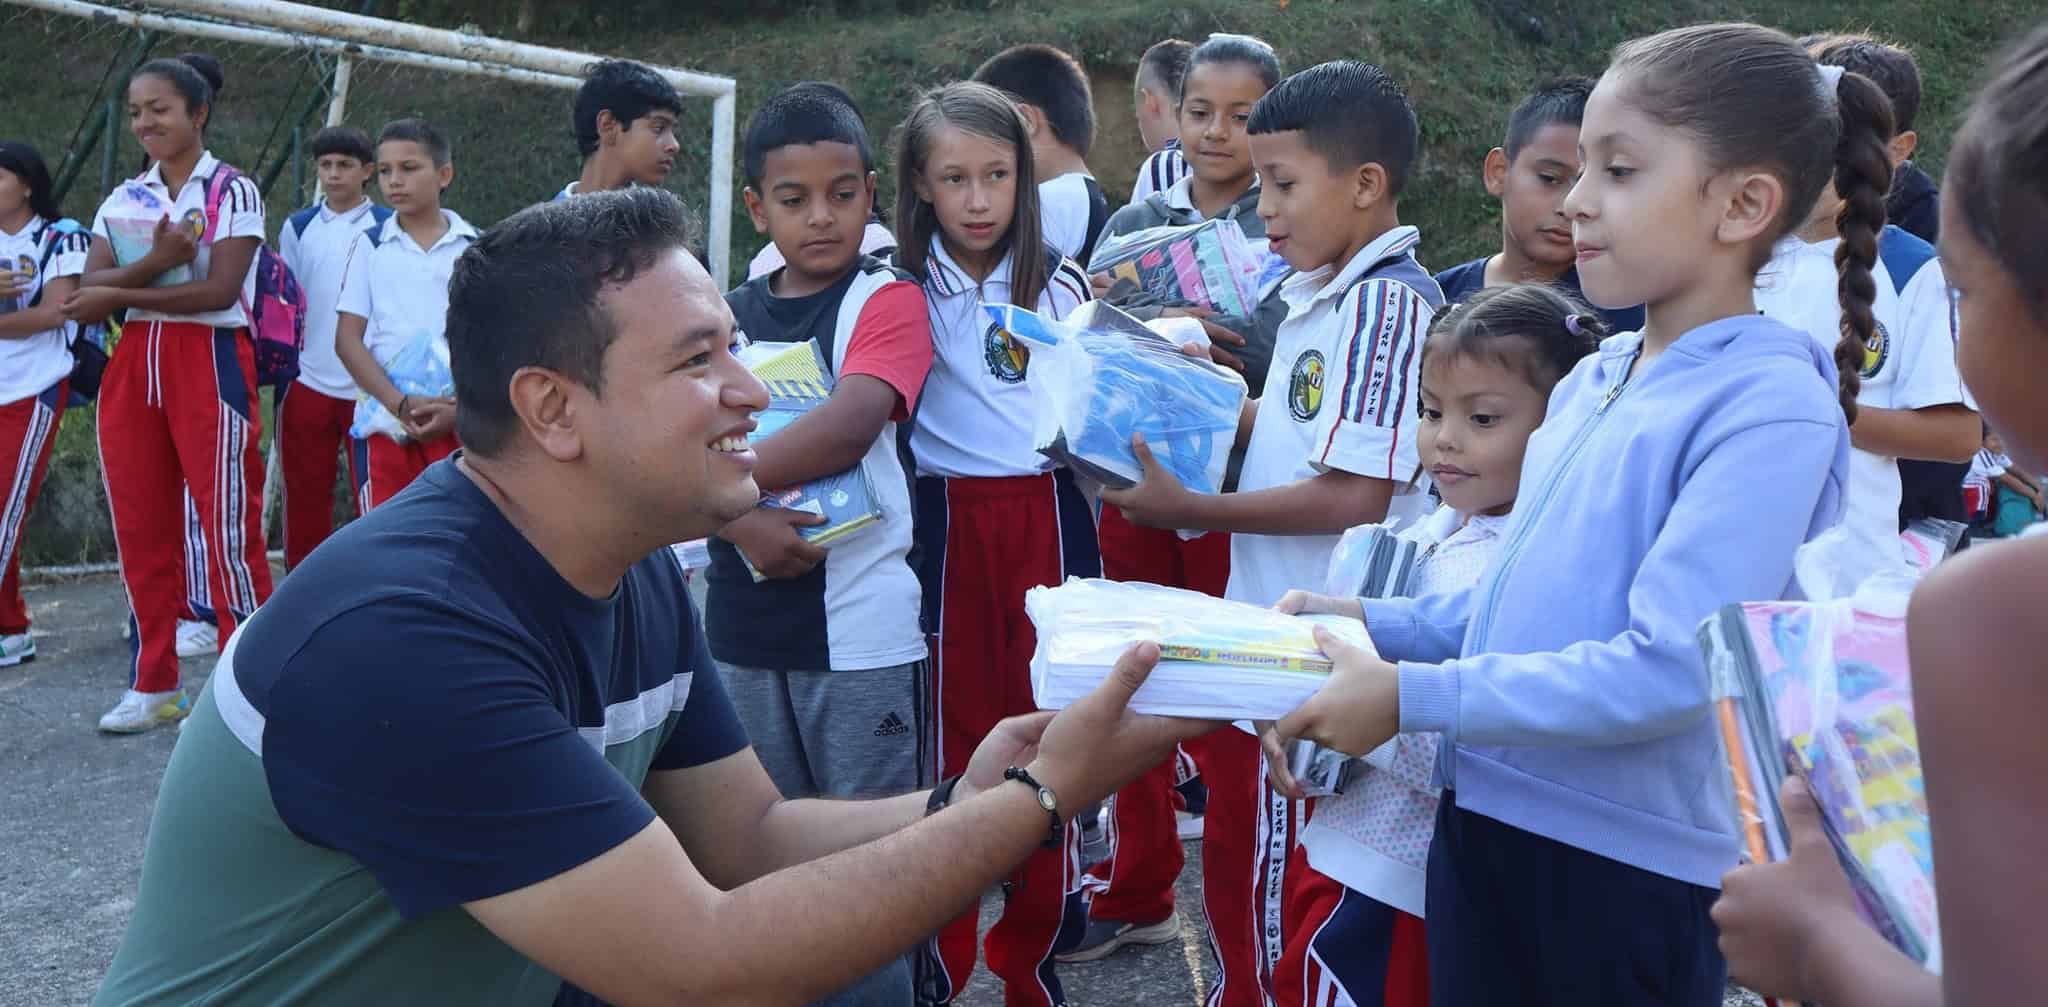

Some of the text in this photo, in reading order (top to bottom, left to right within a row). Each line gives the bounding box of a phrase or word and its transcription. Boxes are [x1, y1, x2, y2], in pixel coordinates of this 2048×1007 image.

[1380, 315, 1394, 347] JUAN
[1367, 369, 1384, 415] WHITE
[1275, 801, 1283, 833] JUAN
[1270, 858, 1282, 898] WHITE
